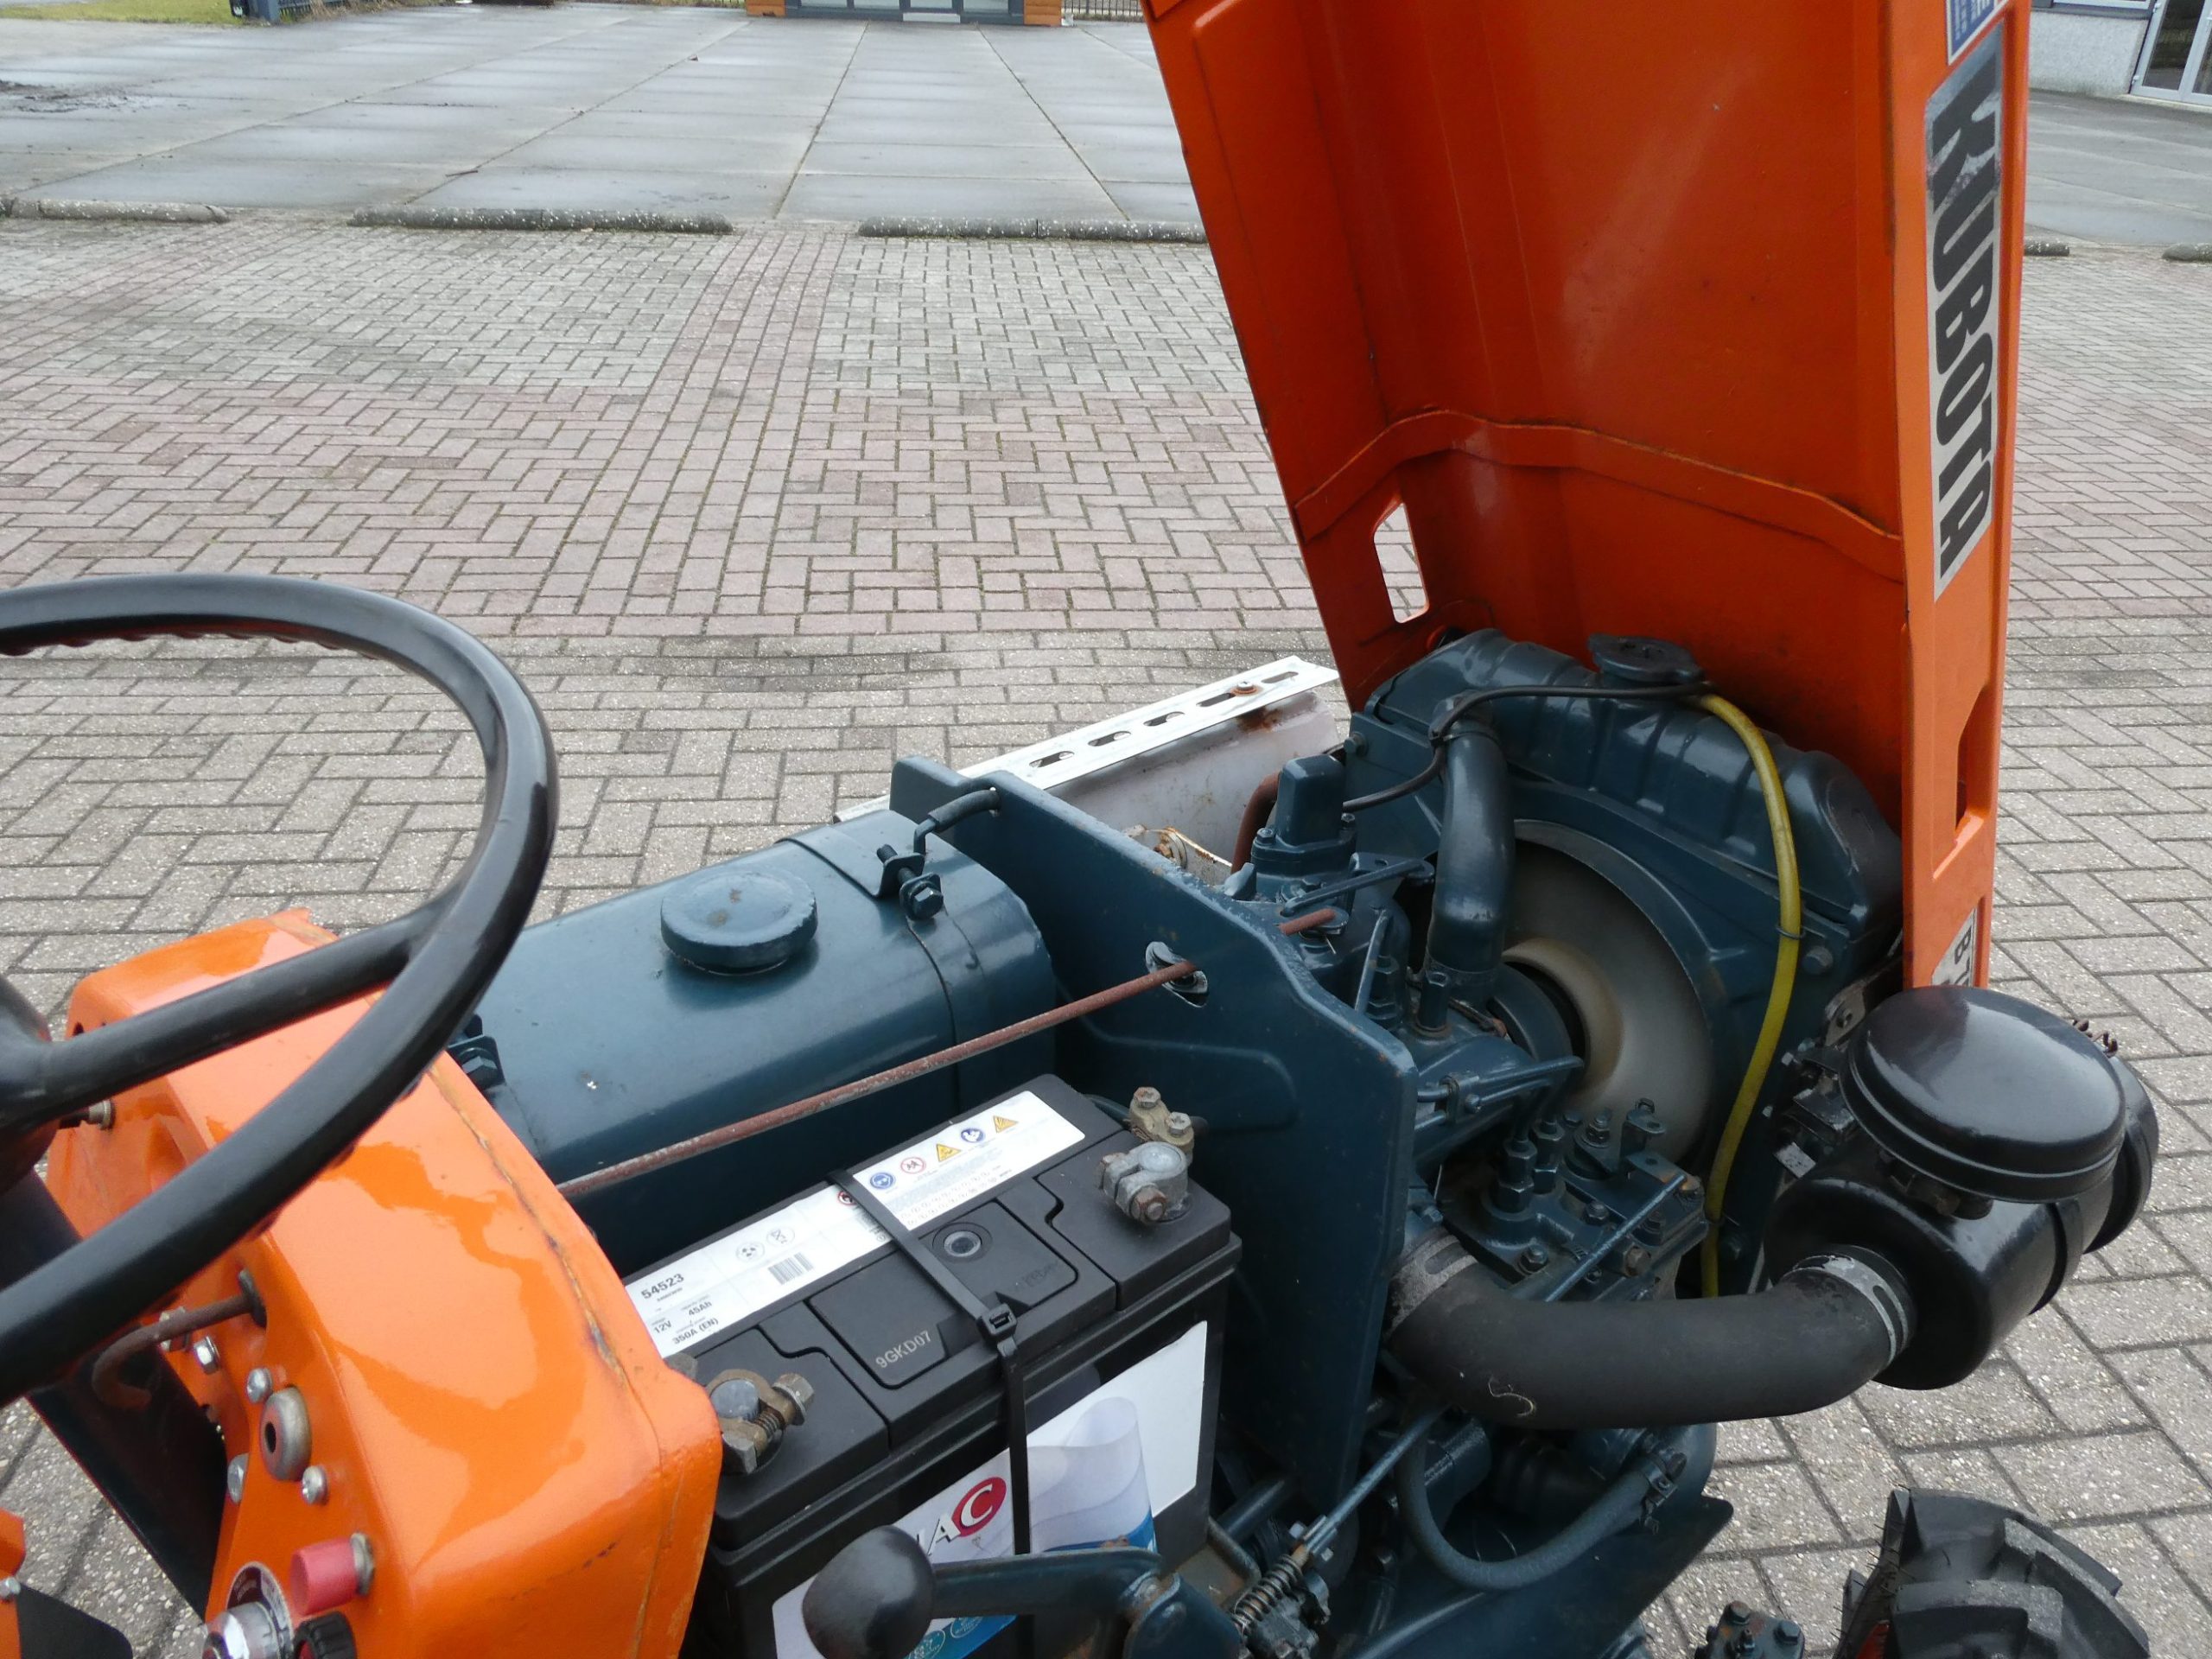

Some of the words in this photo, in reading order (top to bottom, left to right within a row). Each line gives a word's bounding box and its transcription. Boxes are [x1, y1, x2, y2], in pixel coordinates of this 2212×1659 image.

[1931, 52, 1997, 579] KUBOTA
[640, 1273, 684, 1299] 54523
[689, 1300, 712, 1316] 45Ah
[654, 1319, 672, 1333] 12V
[673, 1328, 698, 1344] 350A
[698, 1317, 720, 1332] (EN)
[875, 1329, 931, 1368] 9GKD07
